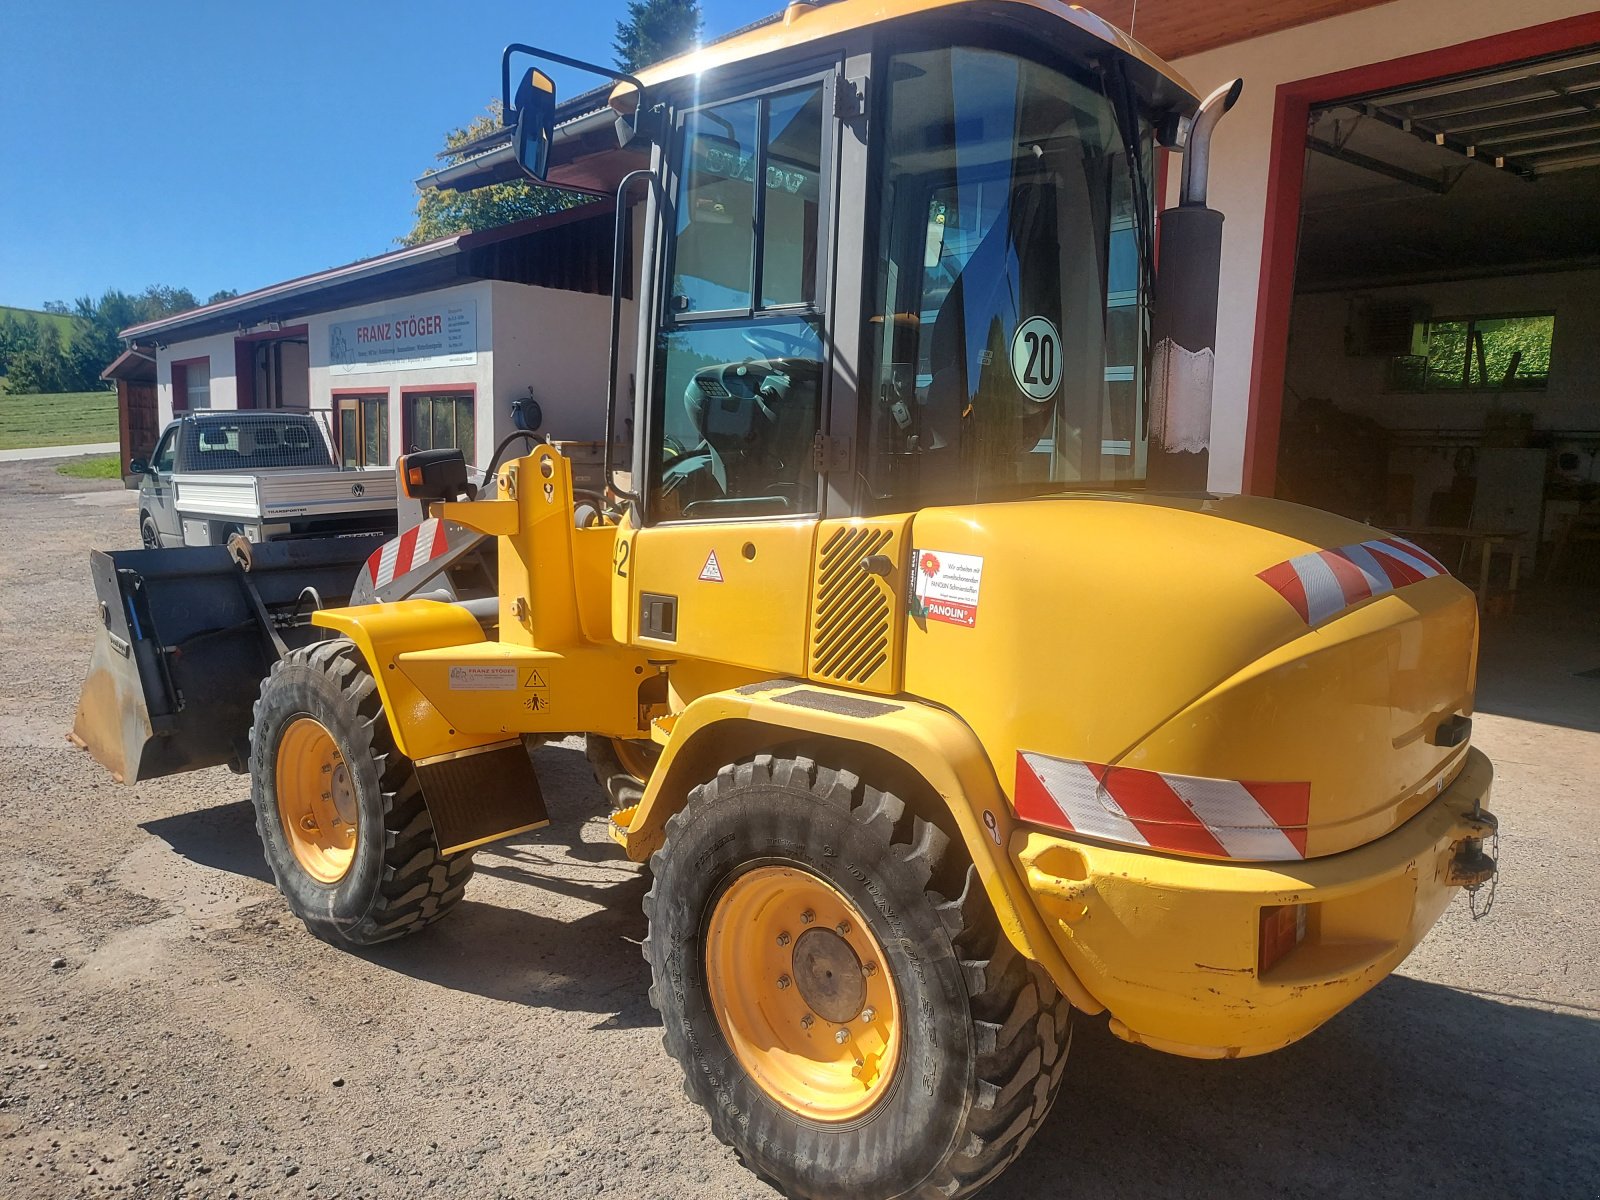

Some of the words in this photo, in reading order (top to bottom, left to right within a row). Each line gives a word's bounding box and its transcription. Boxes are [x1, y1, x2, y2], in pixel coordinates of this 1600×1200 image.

[357, 323, 391, 344] FRANZ
[395, 315, 442, 339] STÖGER
[1023, 331, 1055, 386] 20
[956, 564, 973, 573] arbeiten
[929, 603, 964, 619] PANOLIN
[847, 863, 927, 985] DUNLOP
